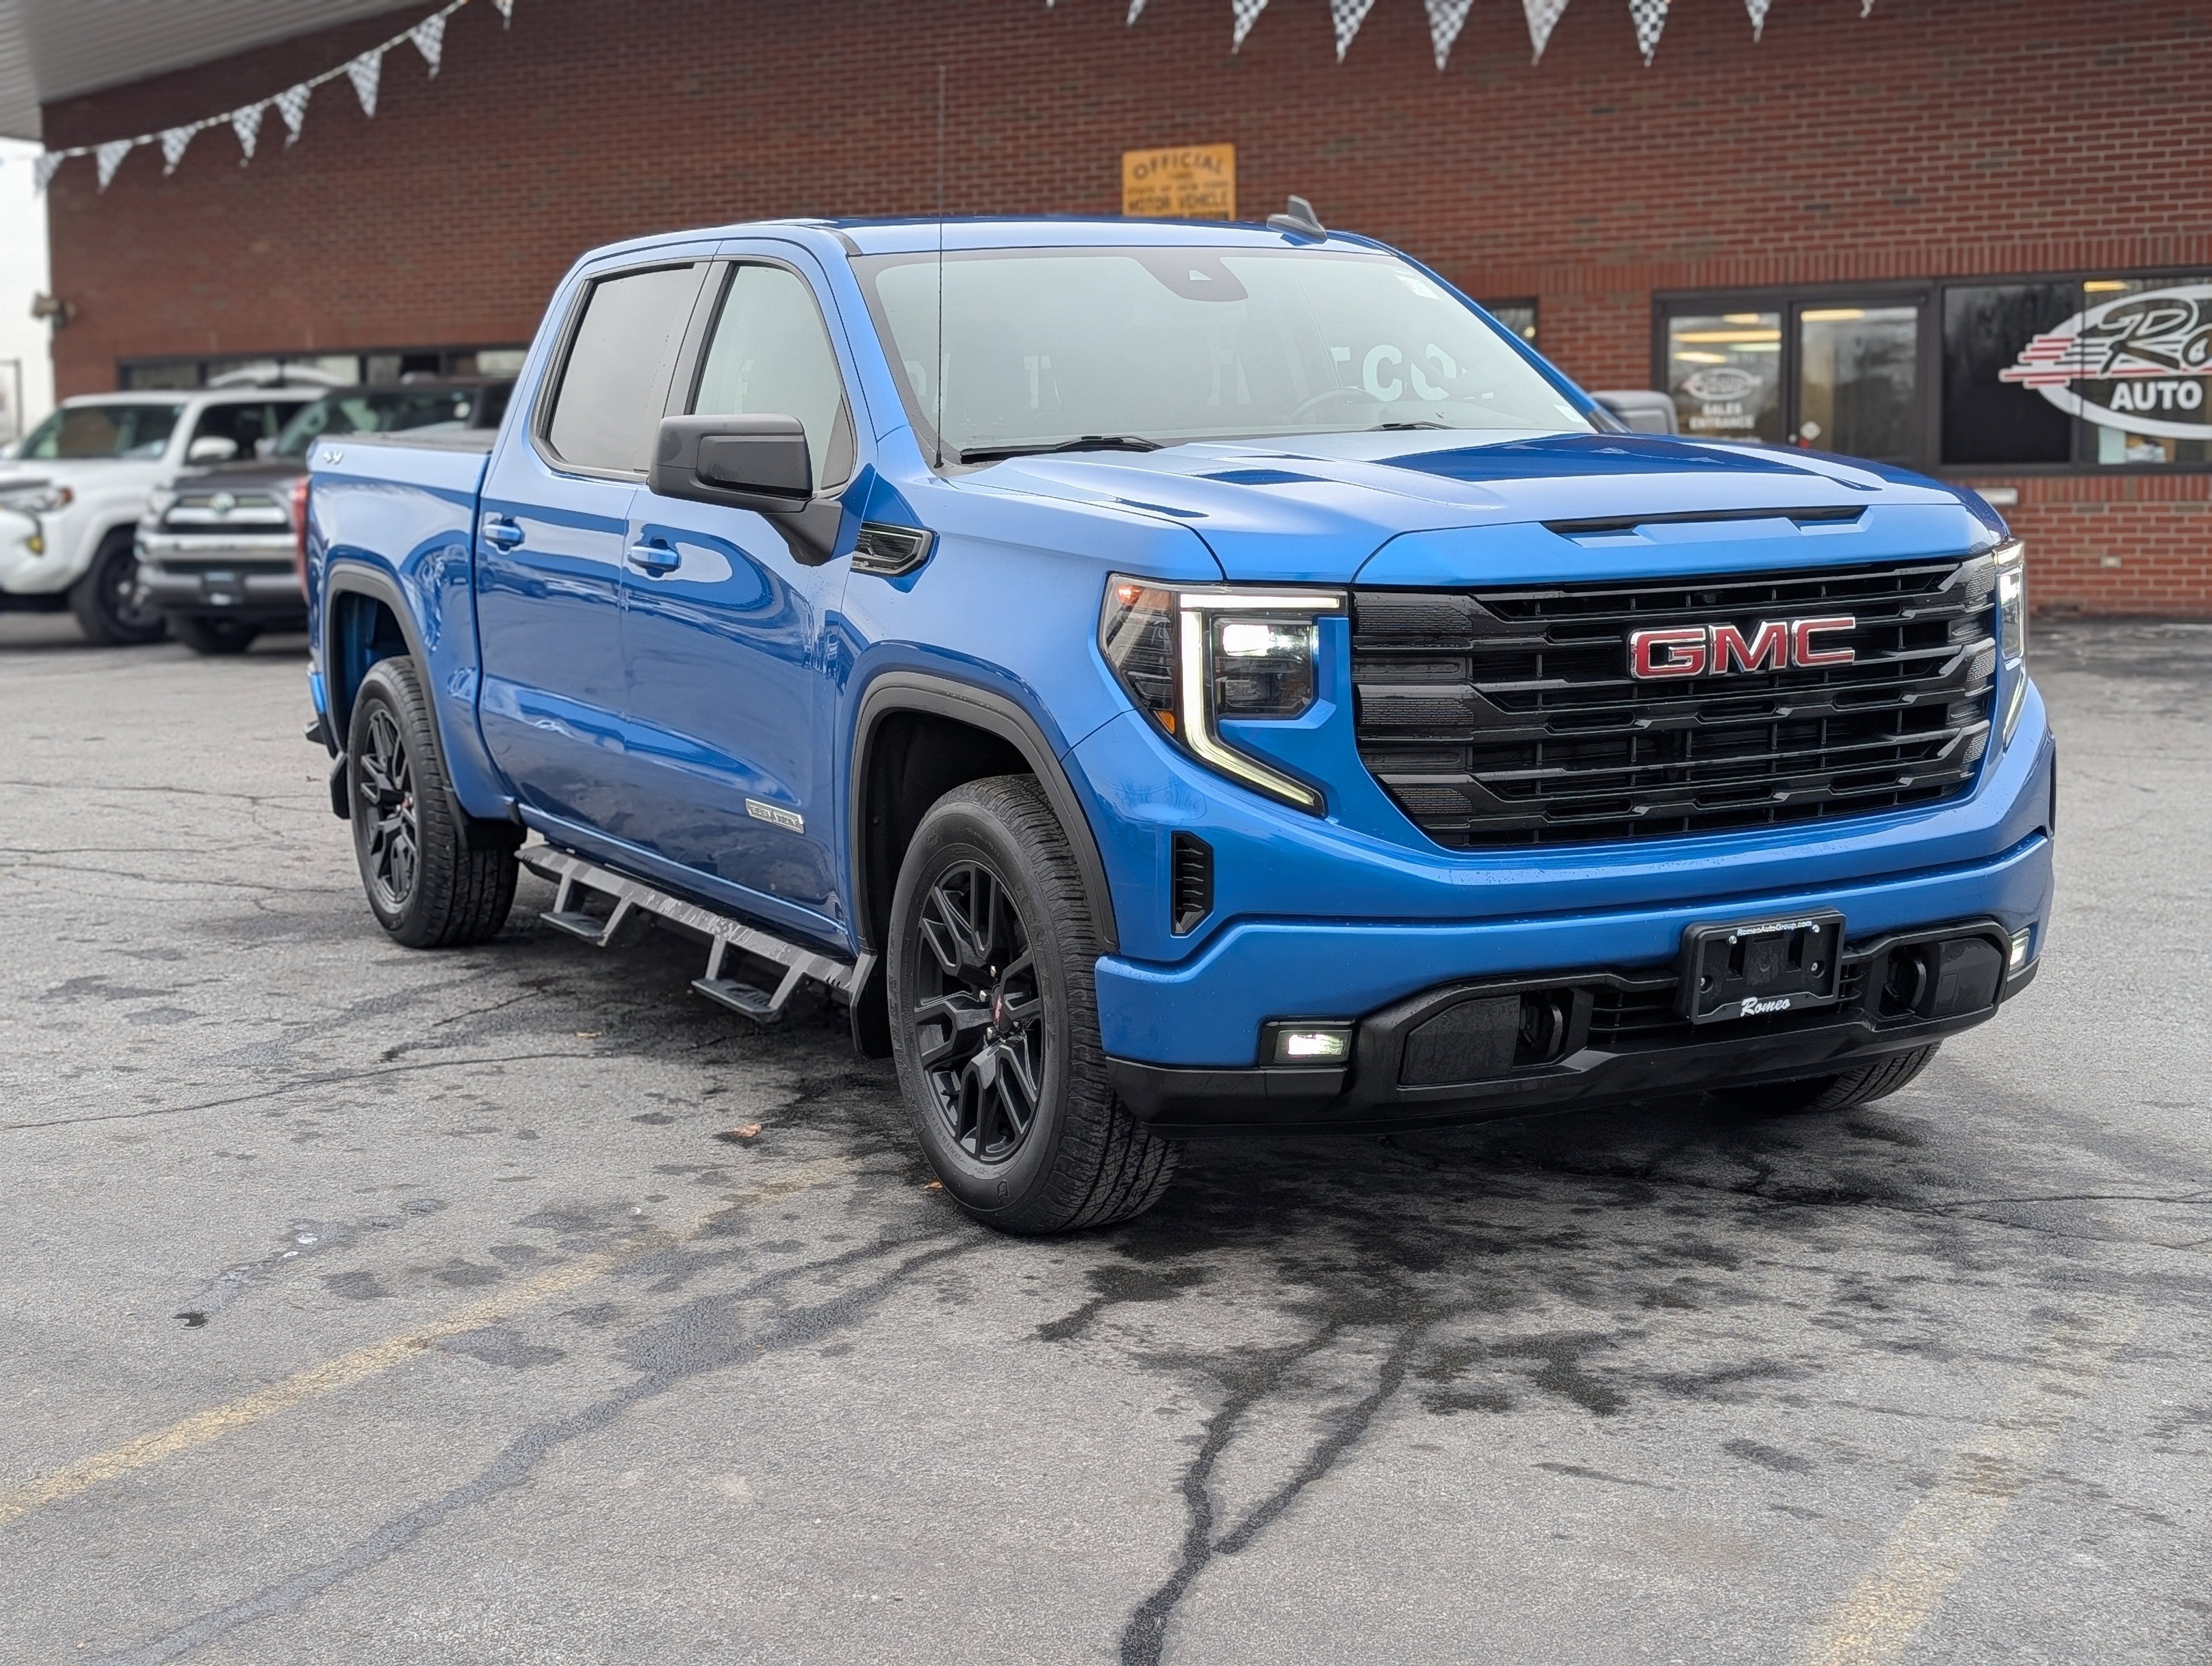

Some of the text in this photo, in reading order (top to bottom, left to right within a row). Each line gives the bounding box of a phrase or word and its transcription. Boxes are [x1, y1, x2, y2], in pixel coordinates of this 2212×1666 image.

[2110, 380, 2203, 411] AUTO
[1630, 617, 1856, 680] GMC
[1740, 997, 1790, 1017] Romeo
